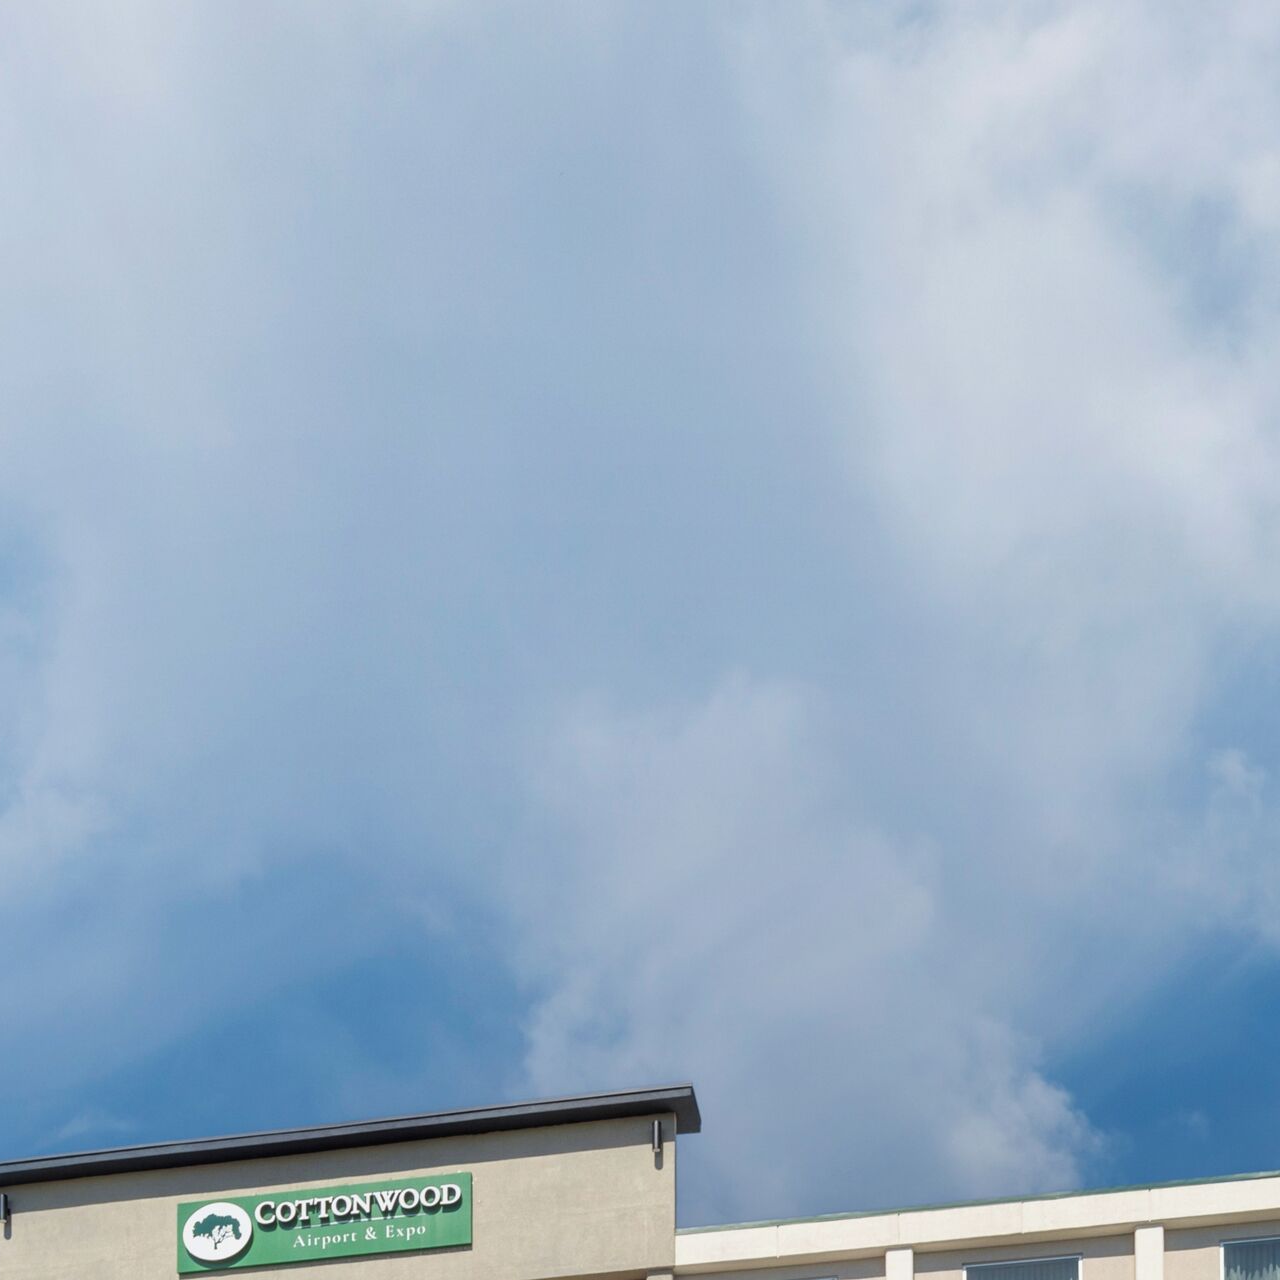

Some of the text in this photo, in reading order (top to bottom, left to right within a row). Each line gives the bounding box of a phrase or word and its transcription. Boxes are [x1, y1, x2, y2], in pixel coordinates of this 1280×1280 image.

[254, 1183, 462, 1225] COTTONWOOD
[293, 1223, 426, 1249] Airport & Expo
